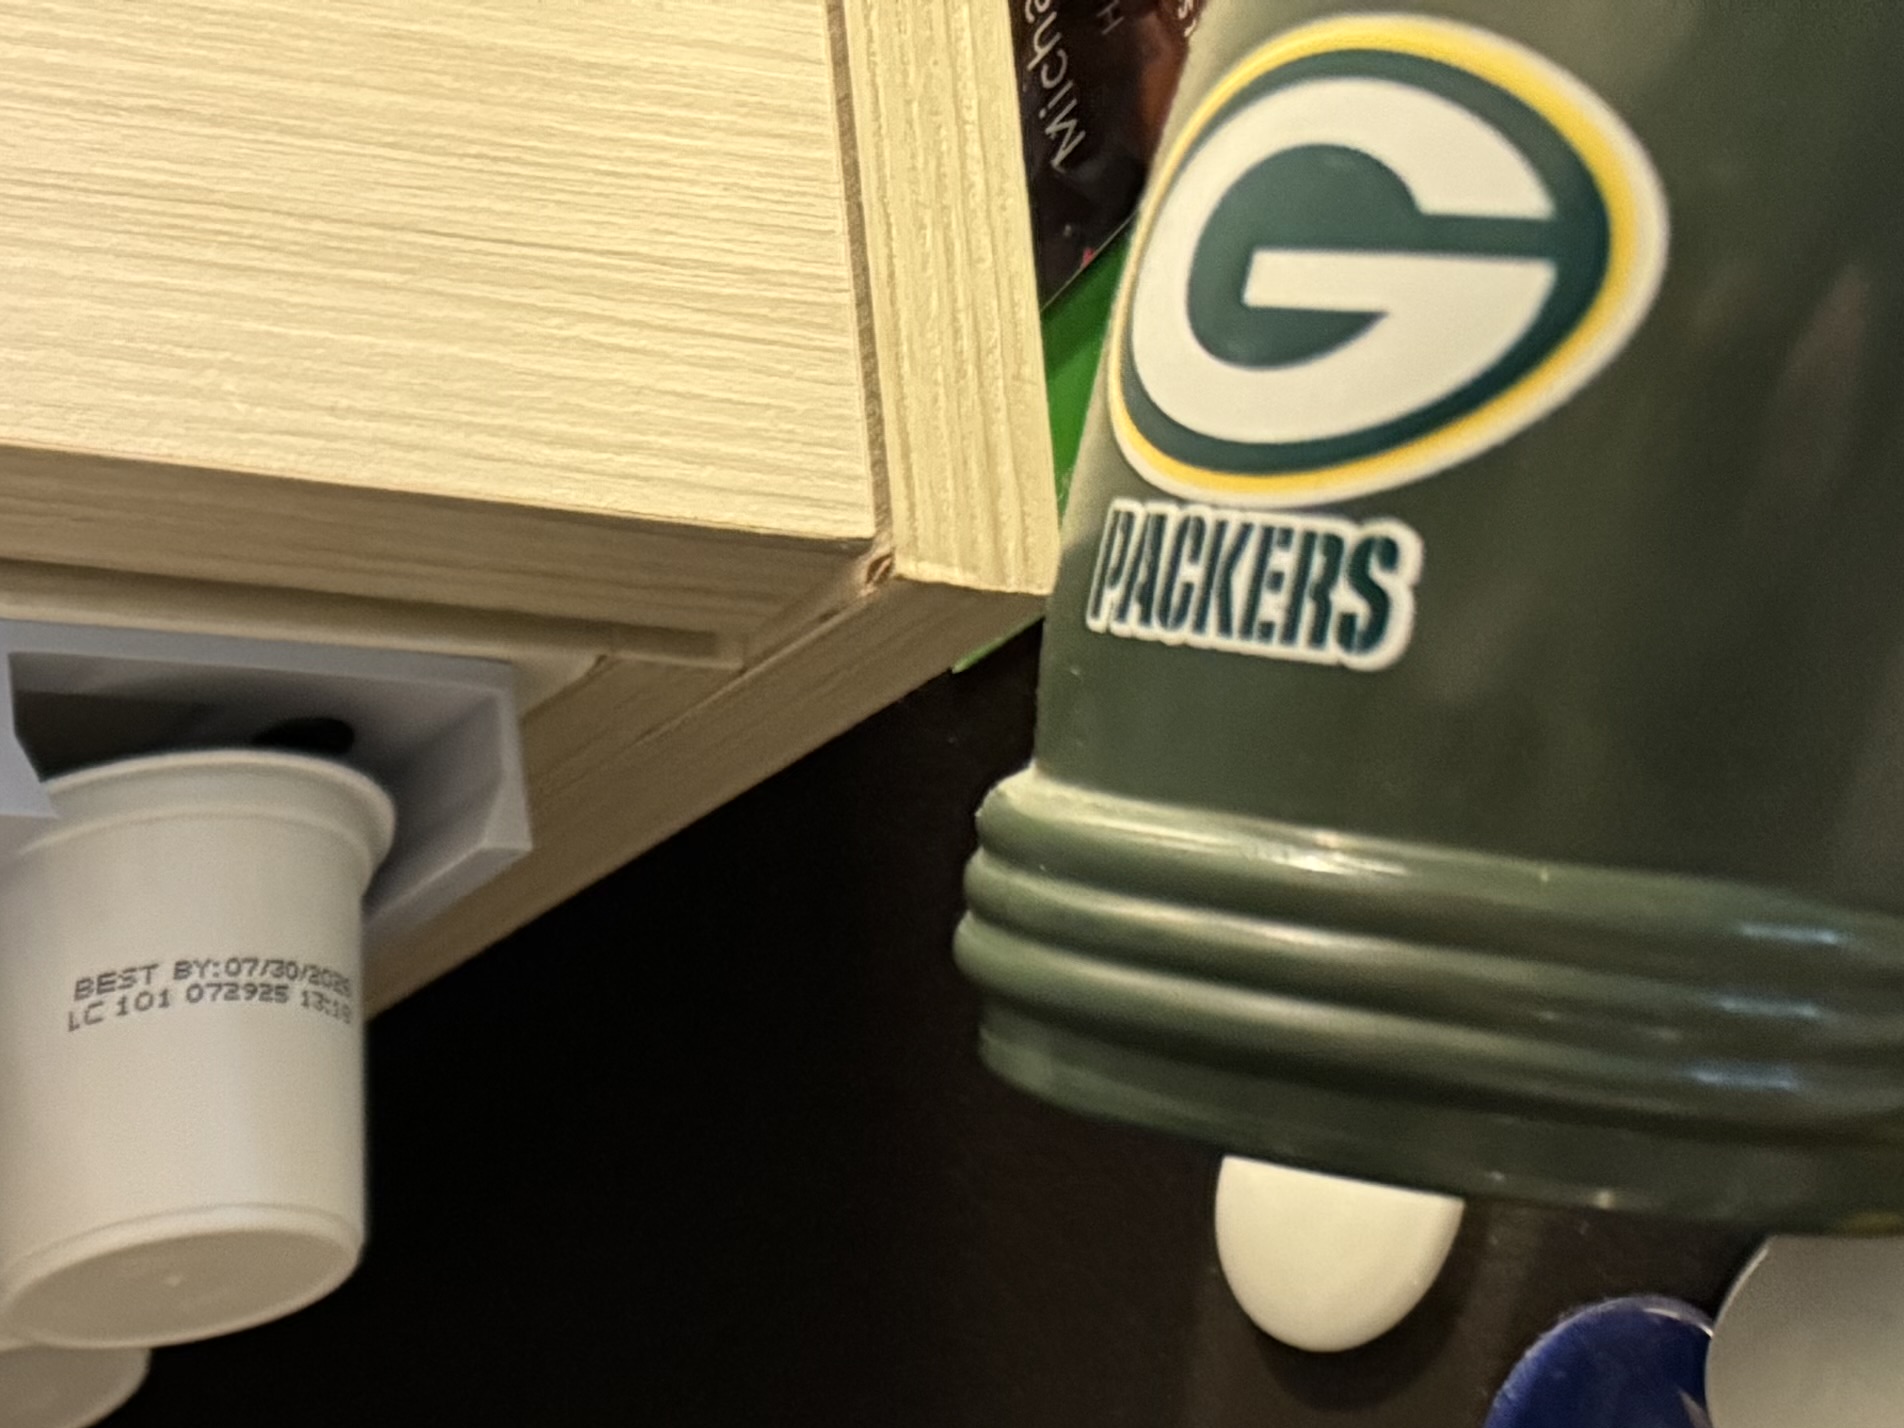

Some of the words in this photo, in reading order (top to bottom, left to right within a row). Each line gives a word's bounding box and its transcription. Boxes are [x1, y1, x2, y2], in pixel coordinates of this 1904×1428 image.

[1132, 77, 1558, 444] G
[1089, 505, 1404, 660] PACKERS
[68, 1000, 105, 1032] LC
[116, 988, 170, 1017] 101
[186, 982, 290, 1004] 072925
[74, 963, 159, 1002] BEST
